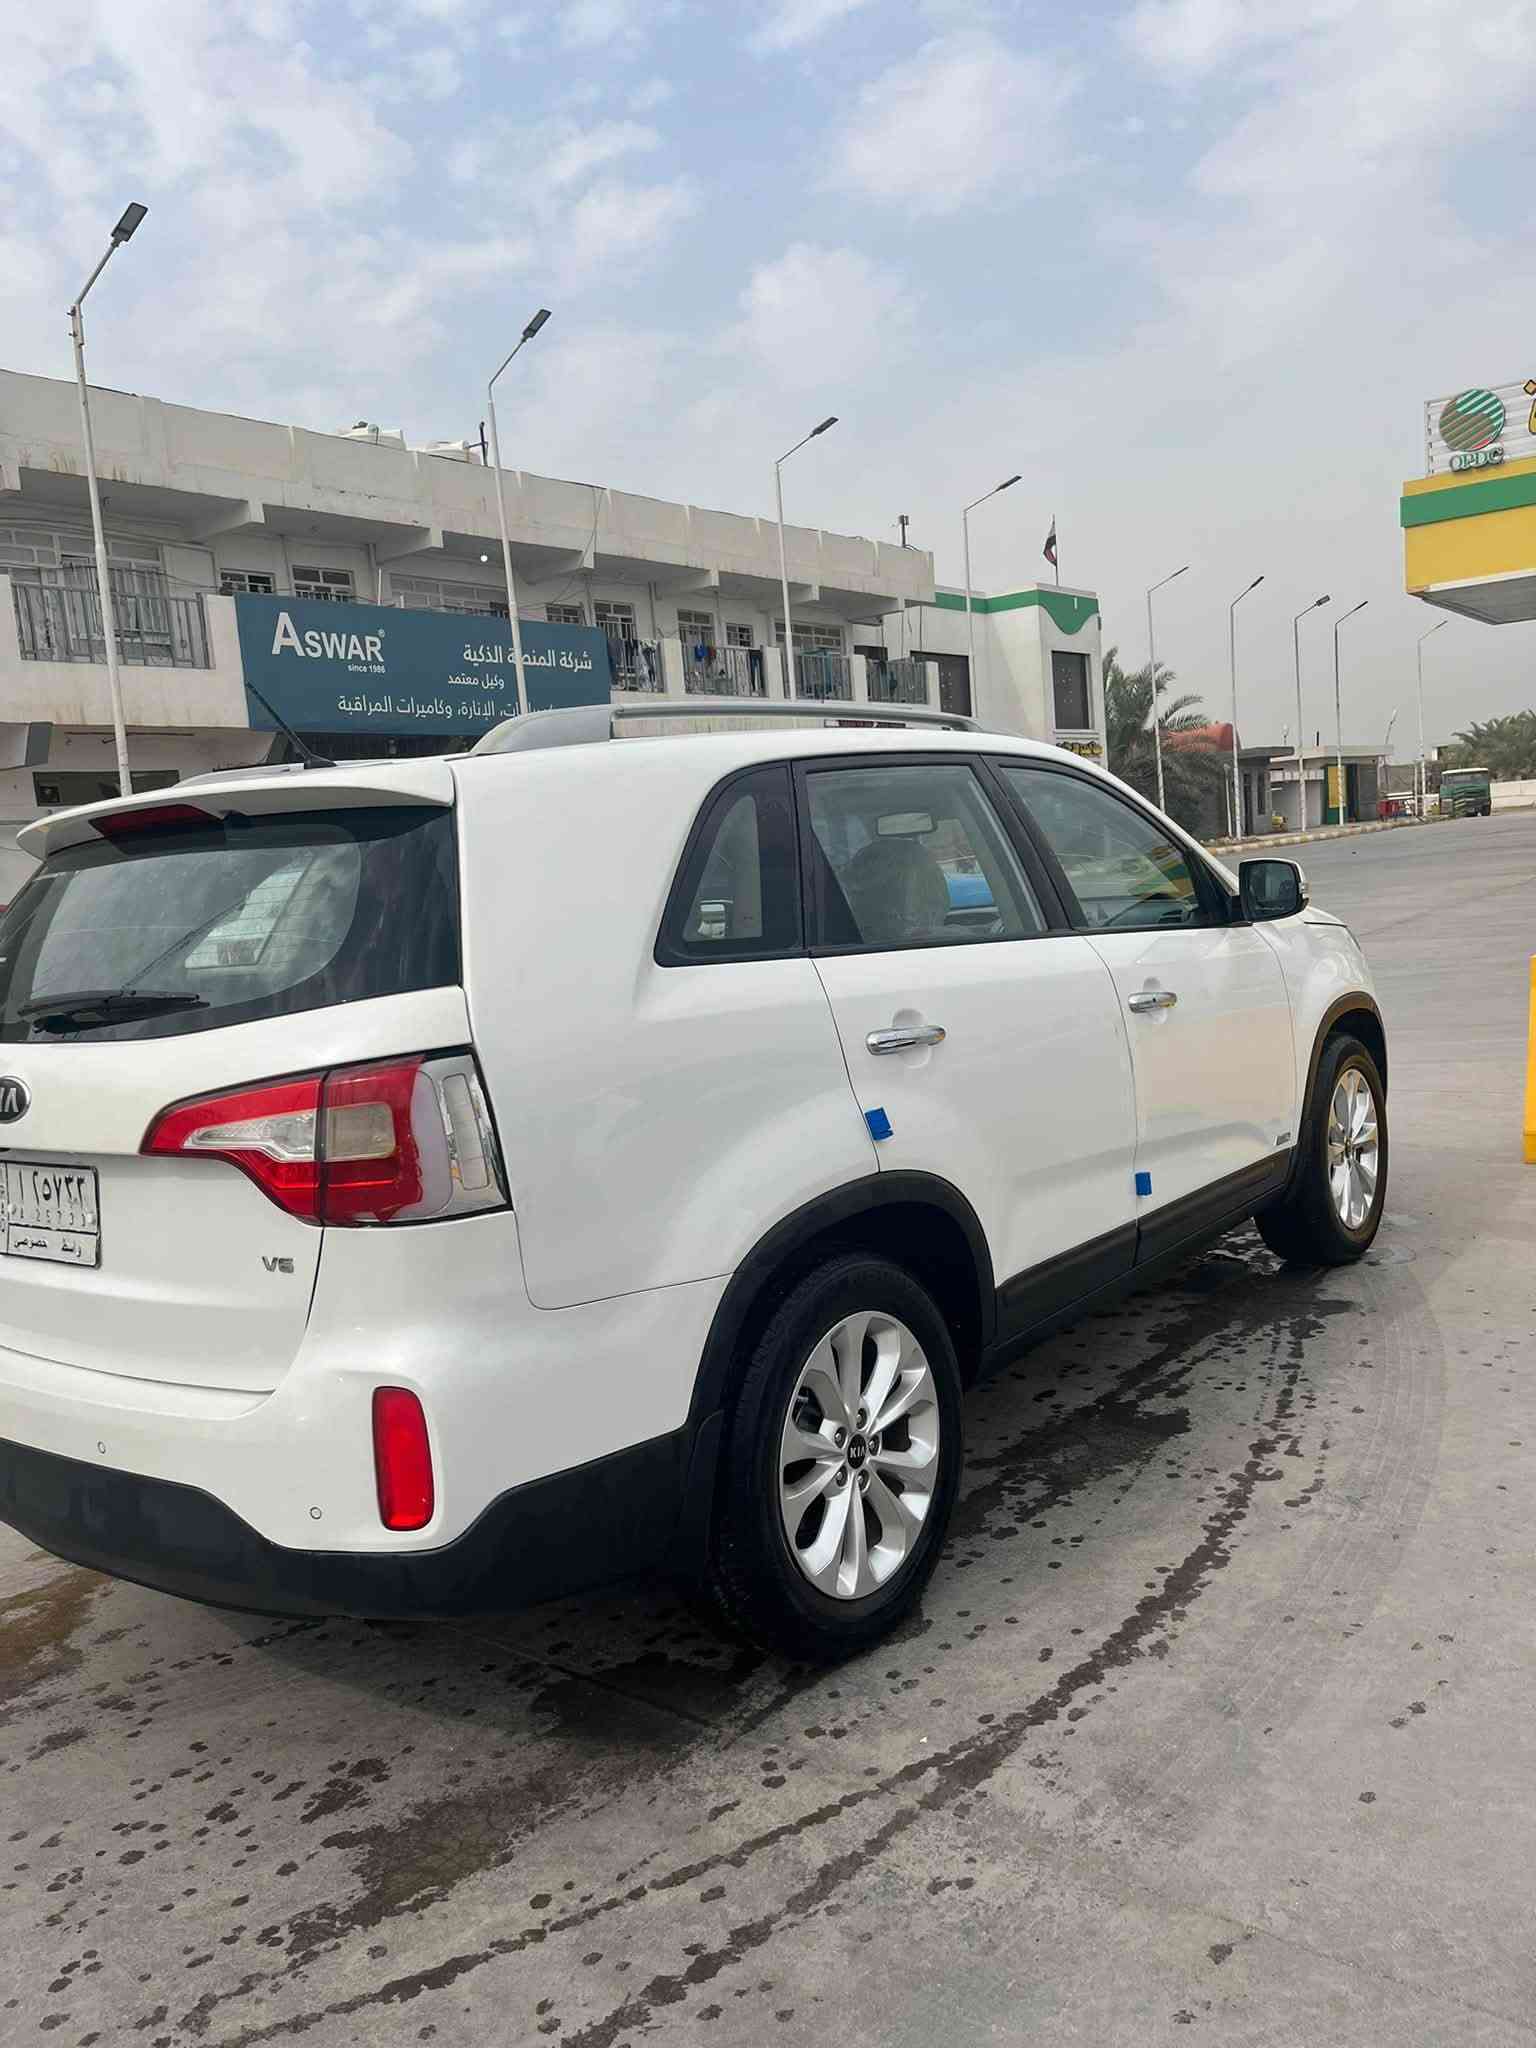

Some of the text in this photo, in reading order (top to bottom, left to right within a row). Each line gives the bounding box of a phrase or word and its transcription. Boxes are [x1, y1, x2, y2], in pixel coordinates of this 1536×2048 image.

[271, 611, 385, 663] ASWAR
[463, 643, 503, 667] الذكية
[560, 649, 593, 673] شركة
[347, 663, 368, 673] since
[447, 672, 505, 690] وكيل معتمد
[338, 693, 393, 717] المراقبة
[397, 696, 453, 719] وكاميرات
[0, 1087, 19, 1113] IA
[261, 1256, 294, 1274] V6
